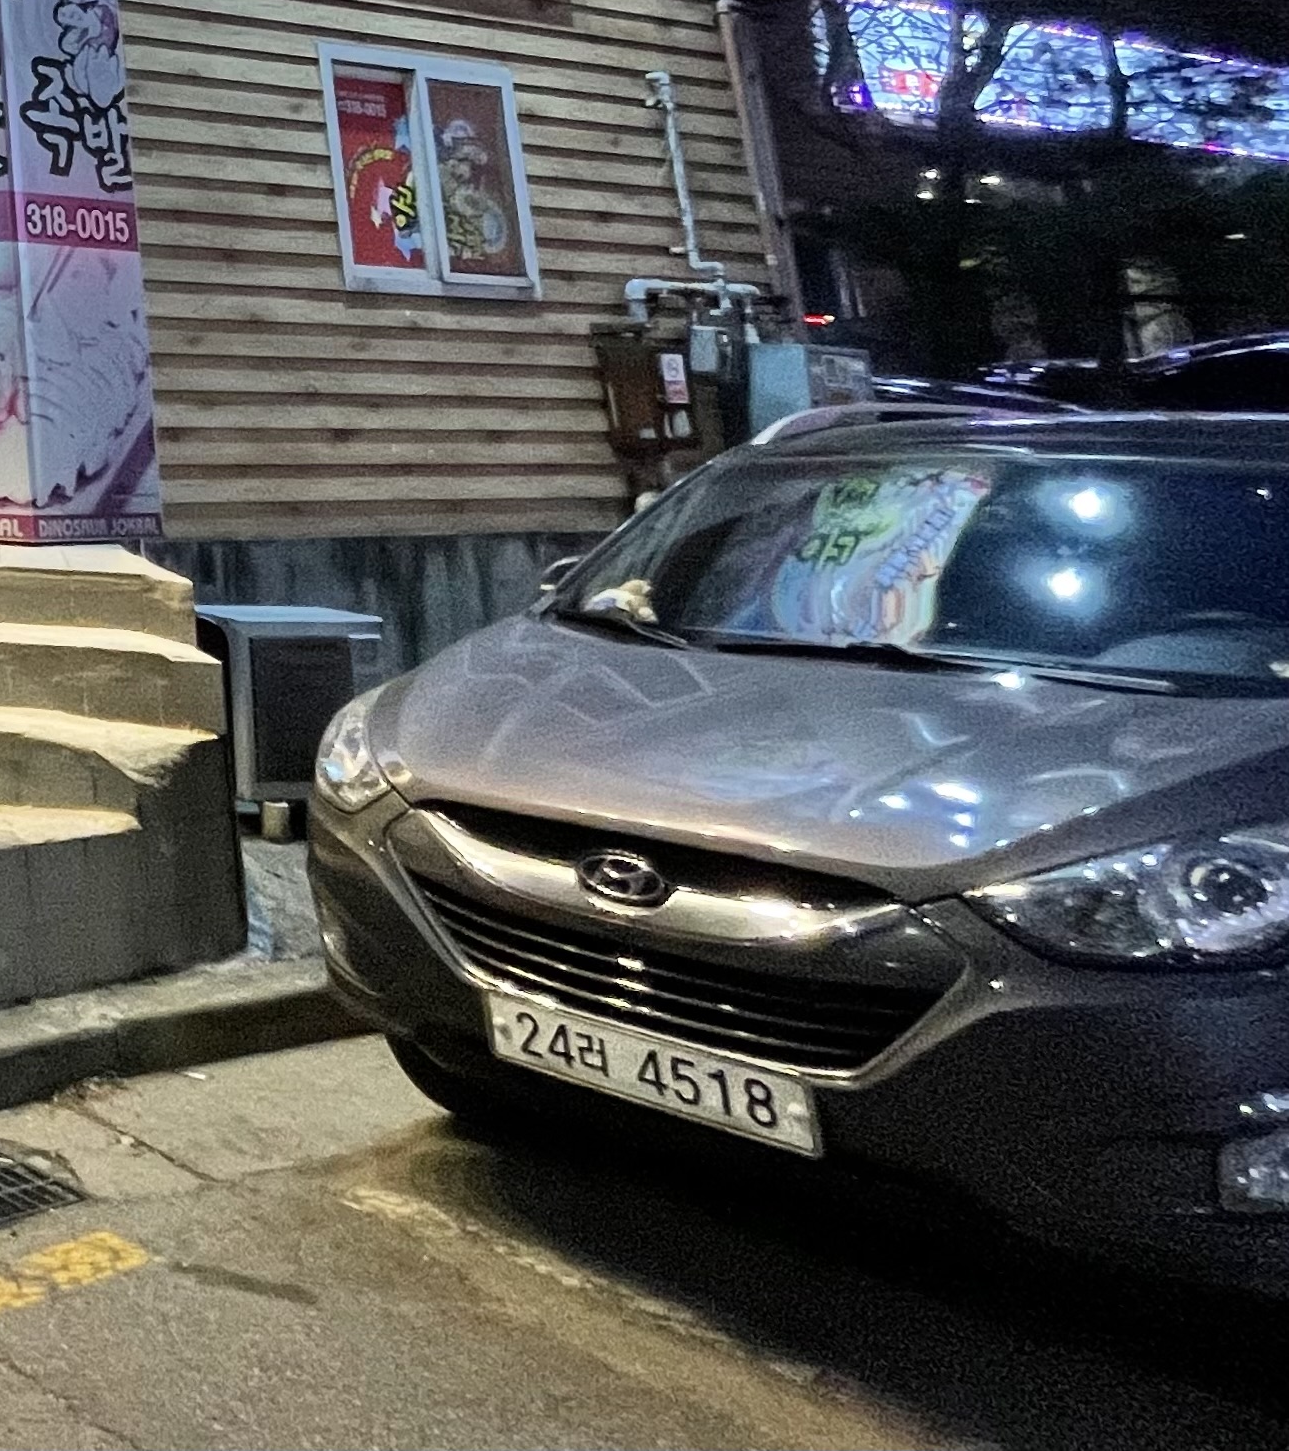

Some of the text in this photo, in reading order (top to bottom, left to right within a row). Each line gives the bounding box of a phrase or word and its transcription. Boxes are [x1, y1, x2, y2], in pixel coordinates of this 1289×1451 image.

[22, 57, 133, 193] 족발
[26, 203, 130, 243] 318-0015
[38, 516, 107, 538] DINOSAUR
[637, 1051, 777, 1128] 4518
